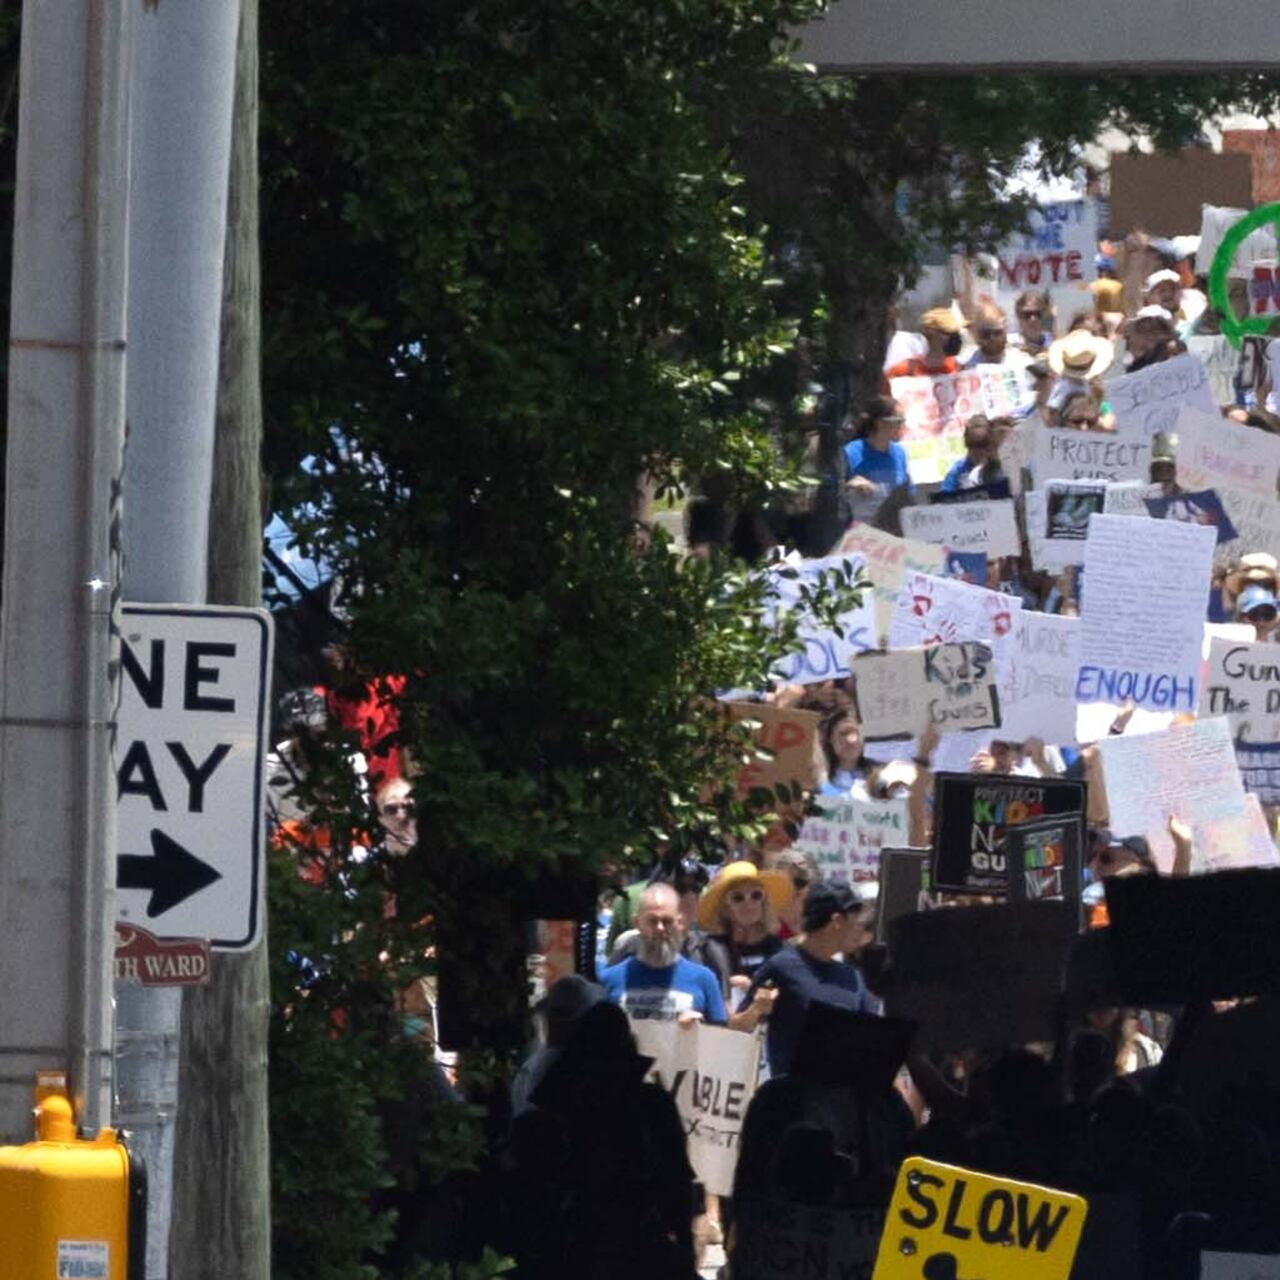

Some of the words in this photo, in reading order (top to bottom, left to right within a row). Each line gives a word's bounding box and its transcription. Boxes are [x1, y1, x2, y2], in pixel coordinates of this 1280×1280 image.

[999, 252, 1082, 287] VOTE
[1050, 435, 1148, 467] PROTECT
[120, 638, 236, 713] NE
[1074, 665, 1195, 711] ENOUGH
[1207, 685, 1251, 714] The
[116, 740, 233, 813] AY
[143, 954, 206, 978] WARD
[901, 1173, 1071, 1254] SLOW
